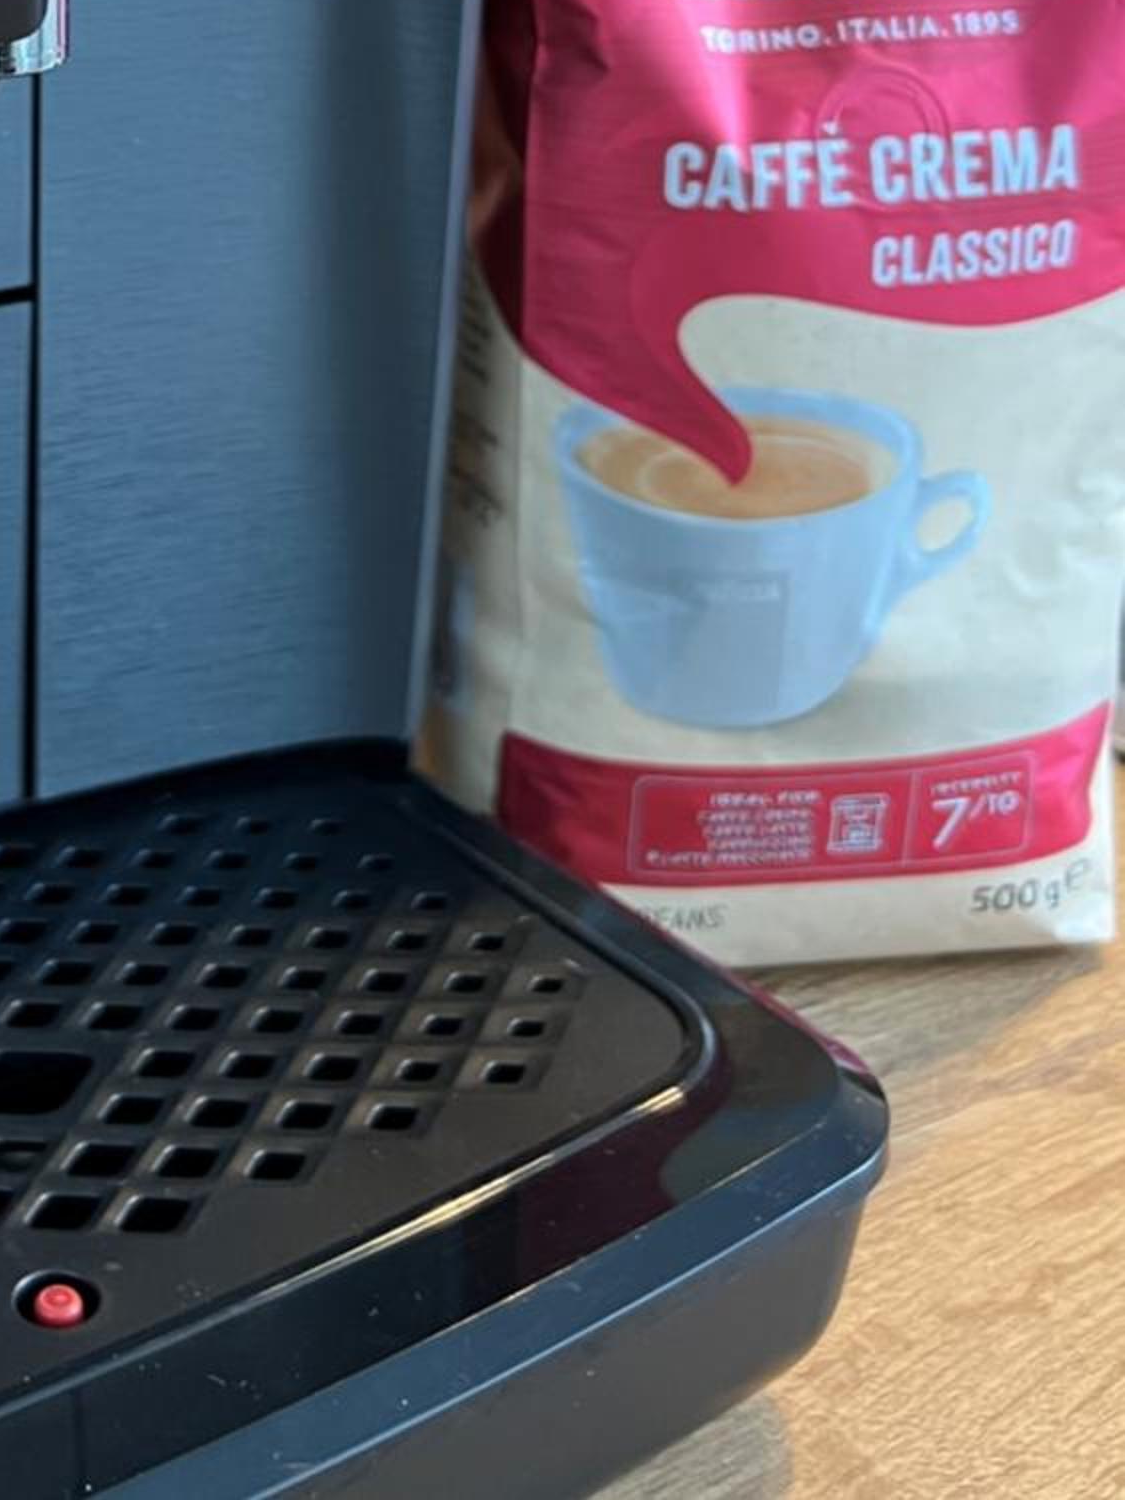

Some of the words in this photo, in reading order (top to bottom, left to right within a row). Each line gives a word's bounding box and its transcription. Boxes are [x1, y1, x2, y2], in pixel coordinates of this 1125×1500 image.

[952, 8, 1022, 37] 1895
[869, 123, 1081, 206] CREMA
[871, 218, 1075, 287] CLASSICO
[971, 877, 1039, 913] 500
